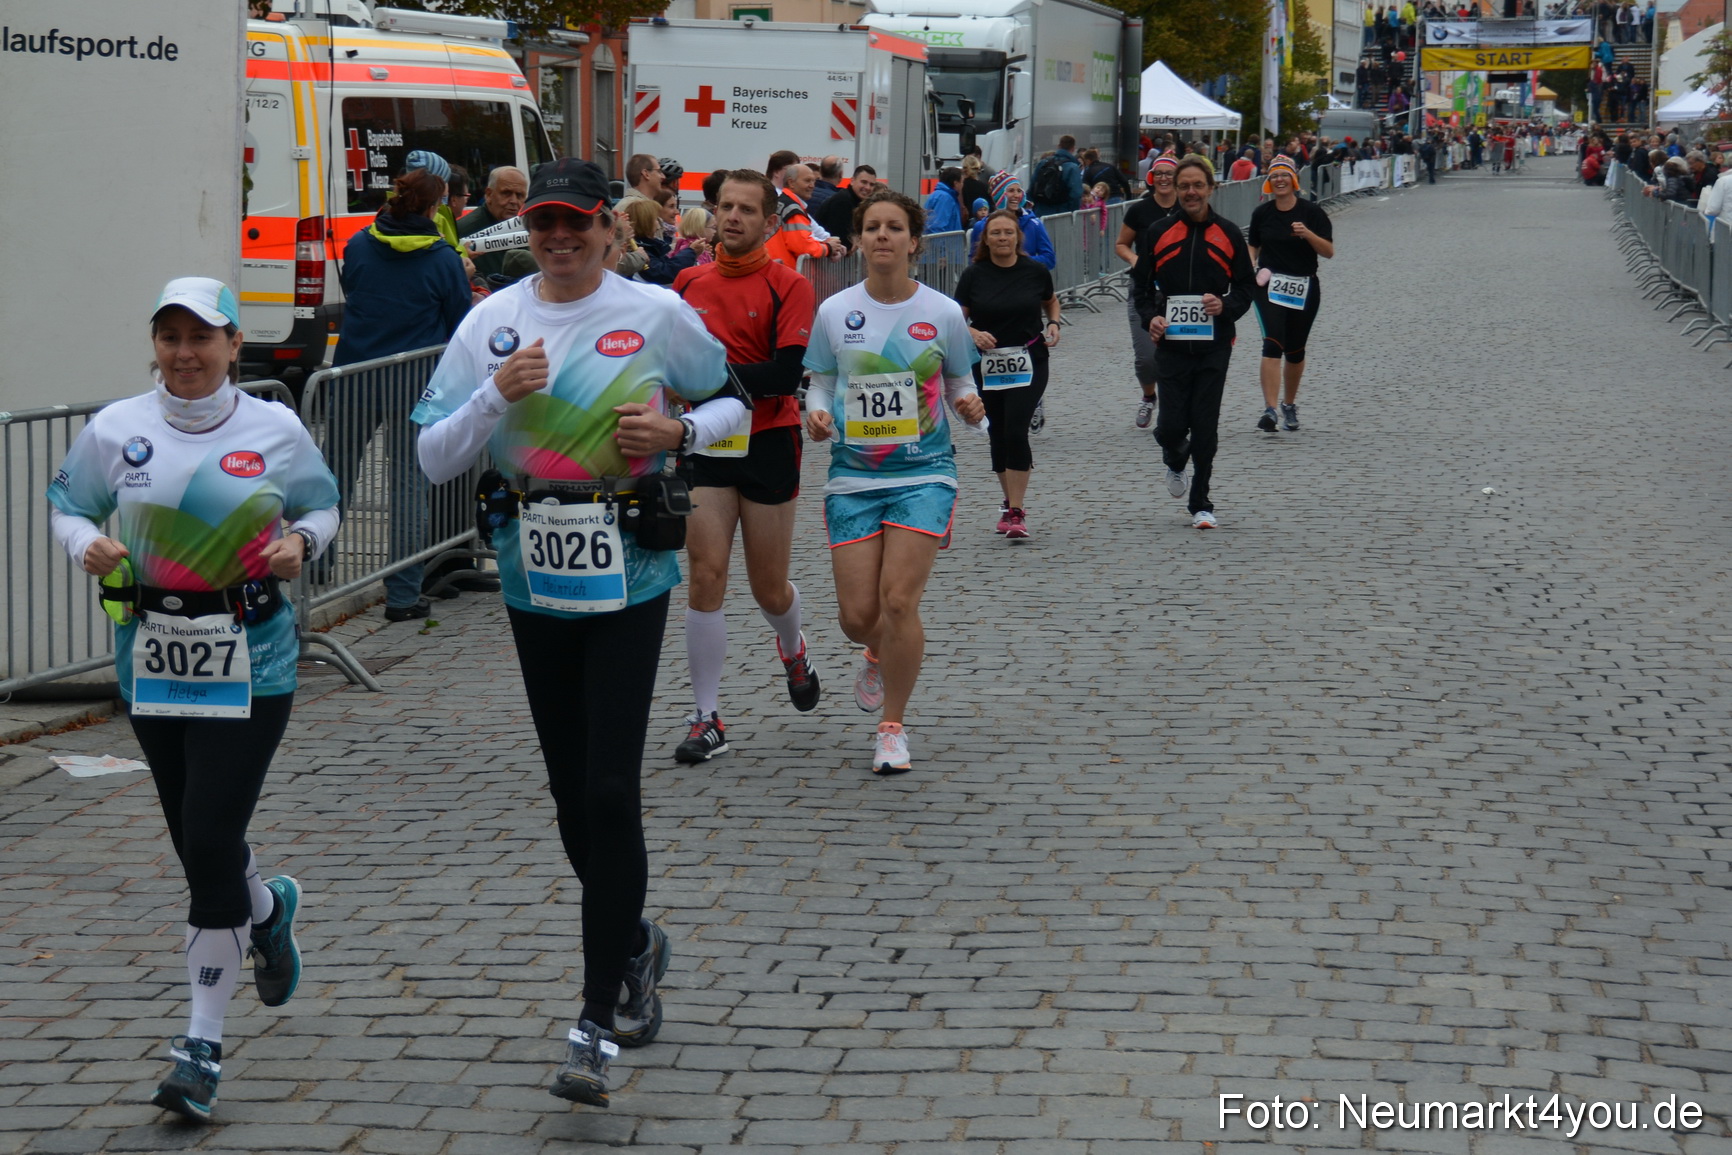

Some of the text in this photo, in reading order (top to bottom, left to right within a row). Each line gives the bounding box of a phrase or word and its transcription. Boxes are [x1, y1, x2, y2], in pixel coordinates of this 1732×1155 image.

[1475, 52, 1533, 66] START
[733, 86, 809, 100] Bayerisches
[732, 102, 768, 114] Rotes
[731, 118, 768, 130] Kreuz
[1145, 115, 1197, 126] Laufsport
[1272, 279, 1305, 297] 2459
[1170, 306, 1209, 323] 2563
[911, 325, 934, 337] Hervis
[602, 336, 640, 351] Hervis
[986, 356, 1028, 374] 2562
[865, 380, 902, 389] Neumarkt
[856, 390, 903, 418] 184
[863, 425, 897, 438] Sophie
[905, 443, 923, 455] 16.
[227, 456, 261, 472] Hervis
[125, 472, 152, 481] PARTL
[521, 511, 600, 526] PARTL Neumarkt
[528, 529, 613, 570] 3026
[542, 576, 587, 597] Heinrich
[139, 621, 226, 637] PARTL Neumarkt
[145, 638, 237, 677] 3027
[167, 681, 208, 703] Helga
[198, 978, 218, 987] cep
